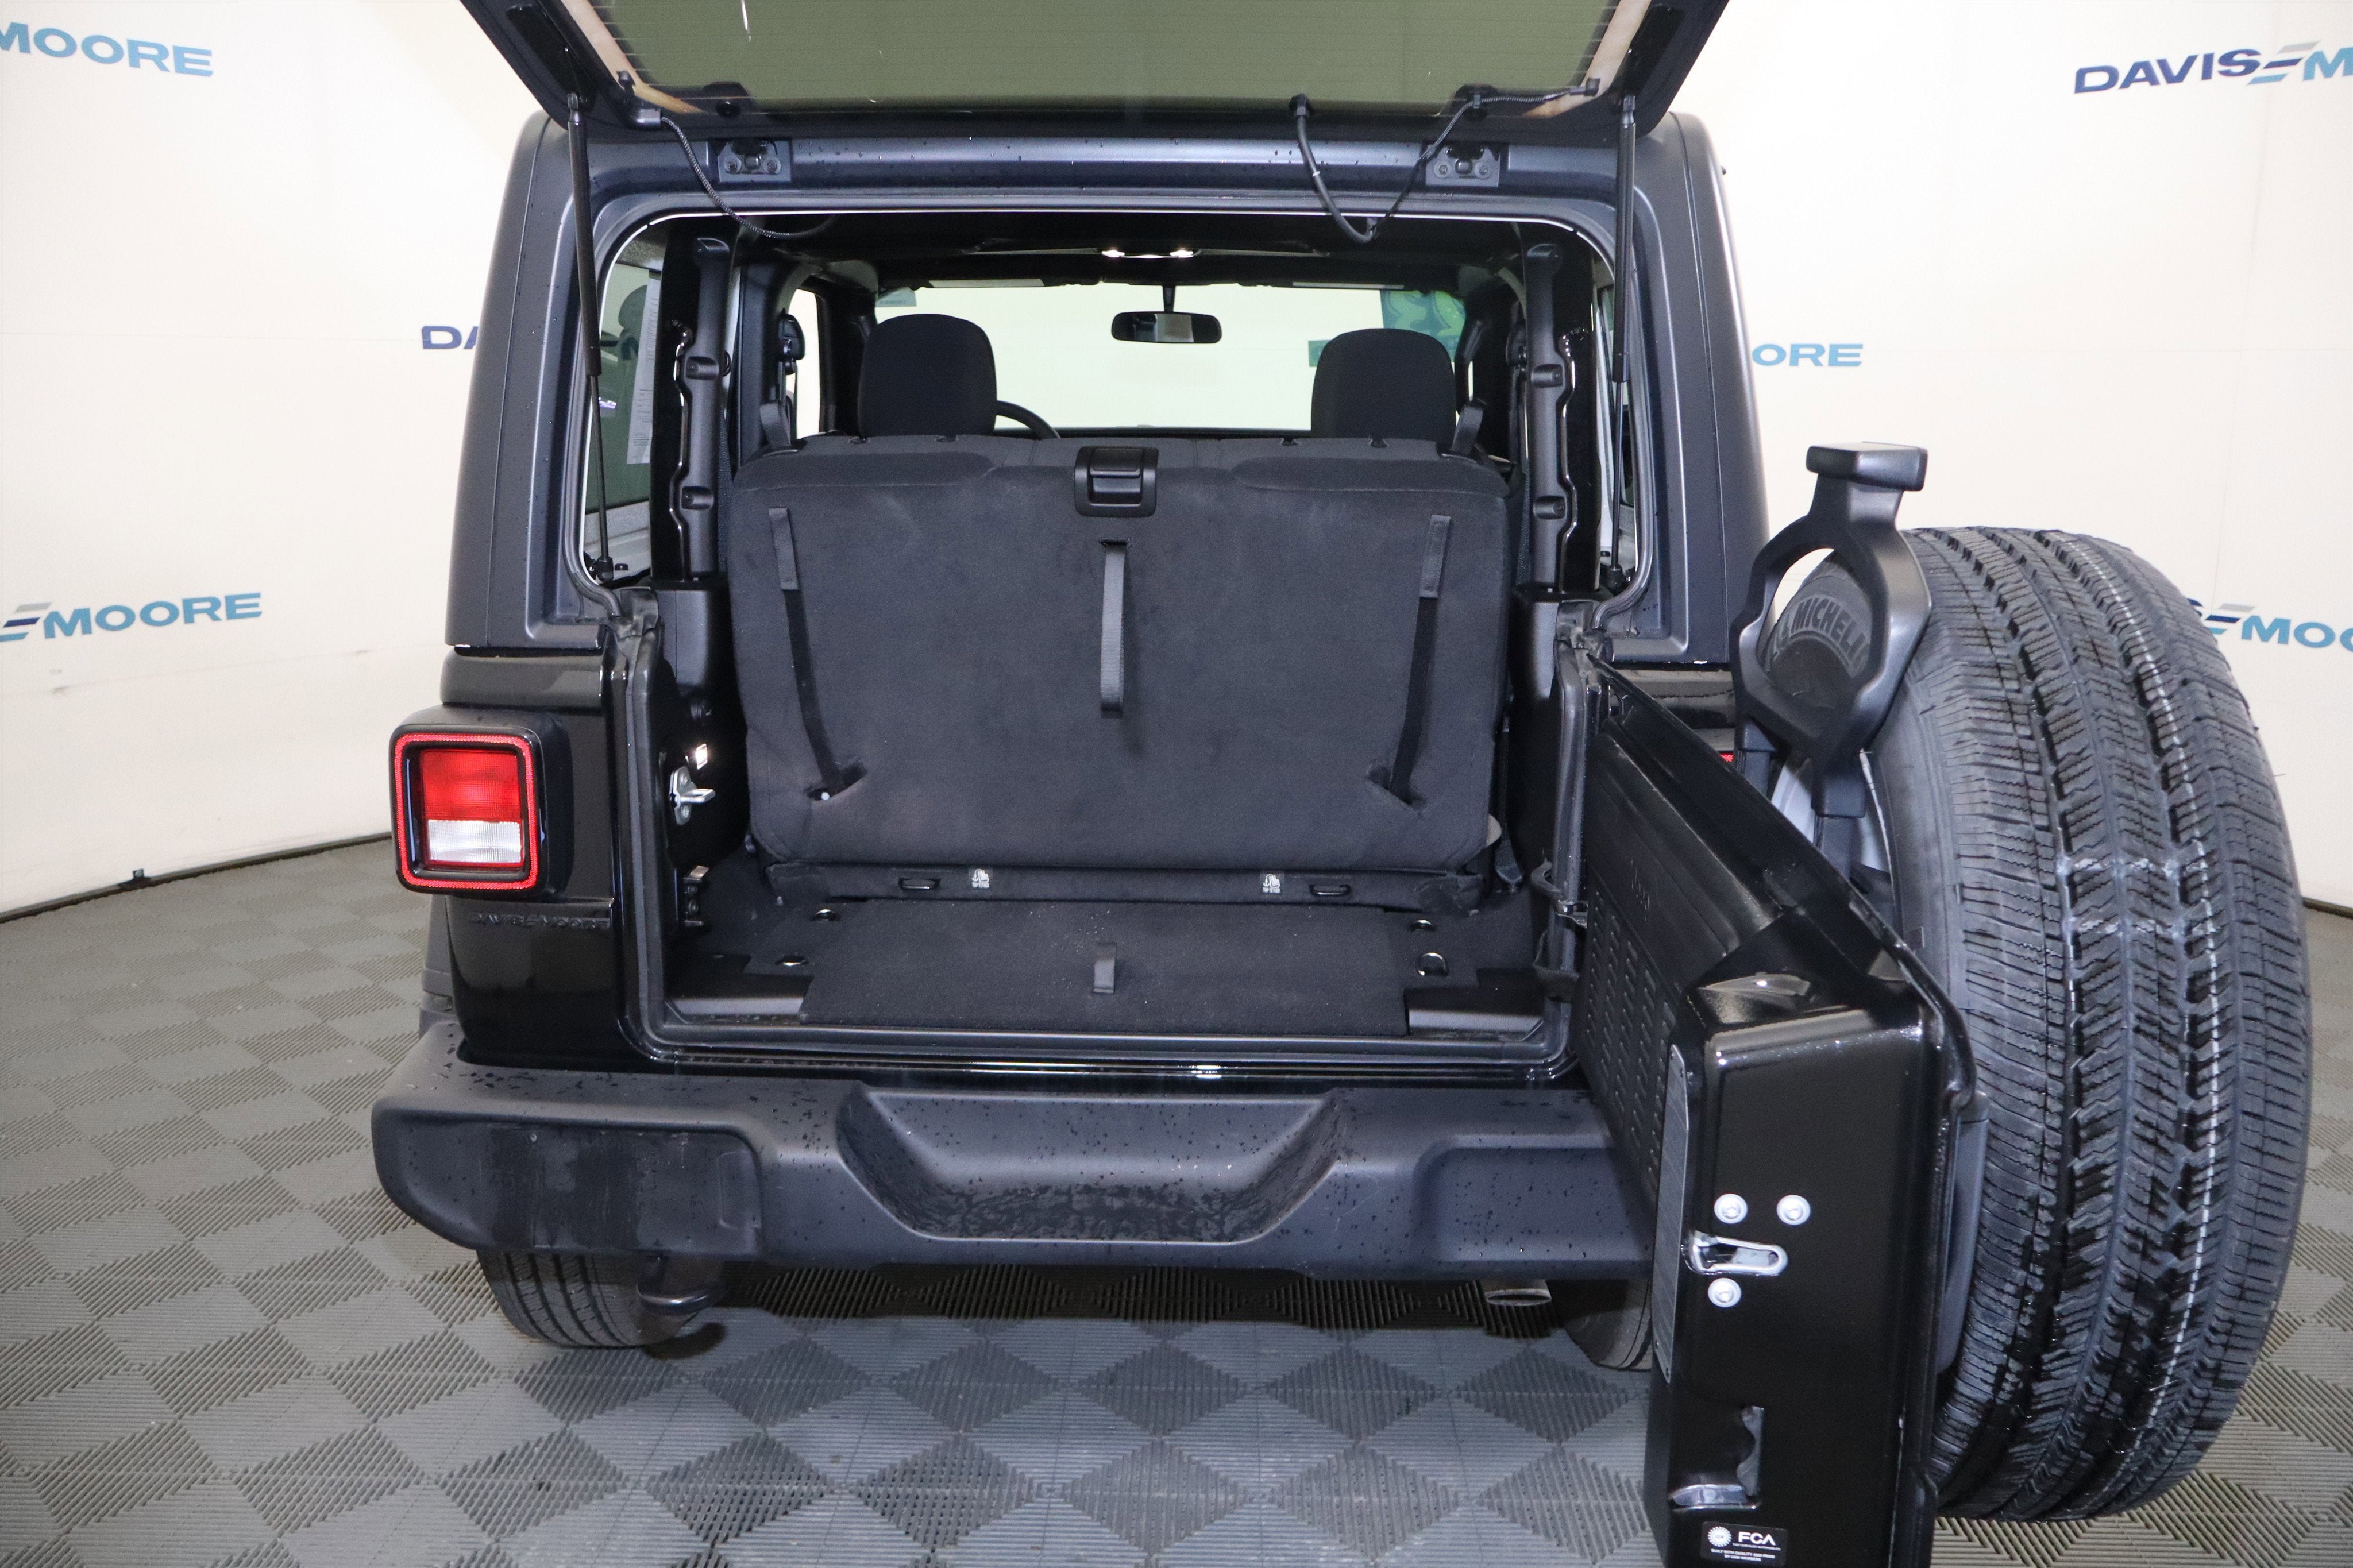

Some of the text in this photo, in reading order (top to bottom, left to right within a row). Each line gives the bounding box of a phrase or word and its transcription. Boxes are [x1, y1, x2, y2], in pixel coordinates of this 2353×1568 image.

[2074, 48, 2262, 94] DAVIS
[43, 592, 263, 639] MOORE
[1738, 1531, 1776, 1546] FCA
